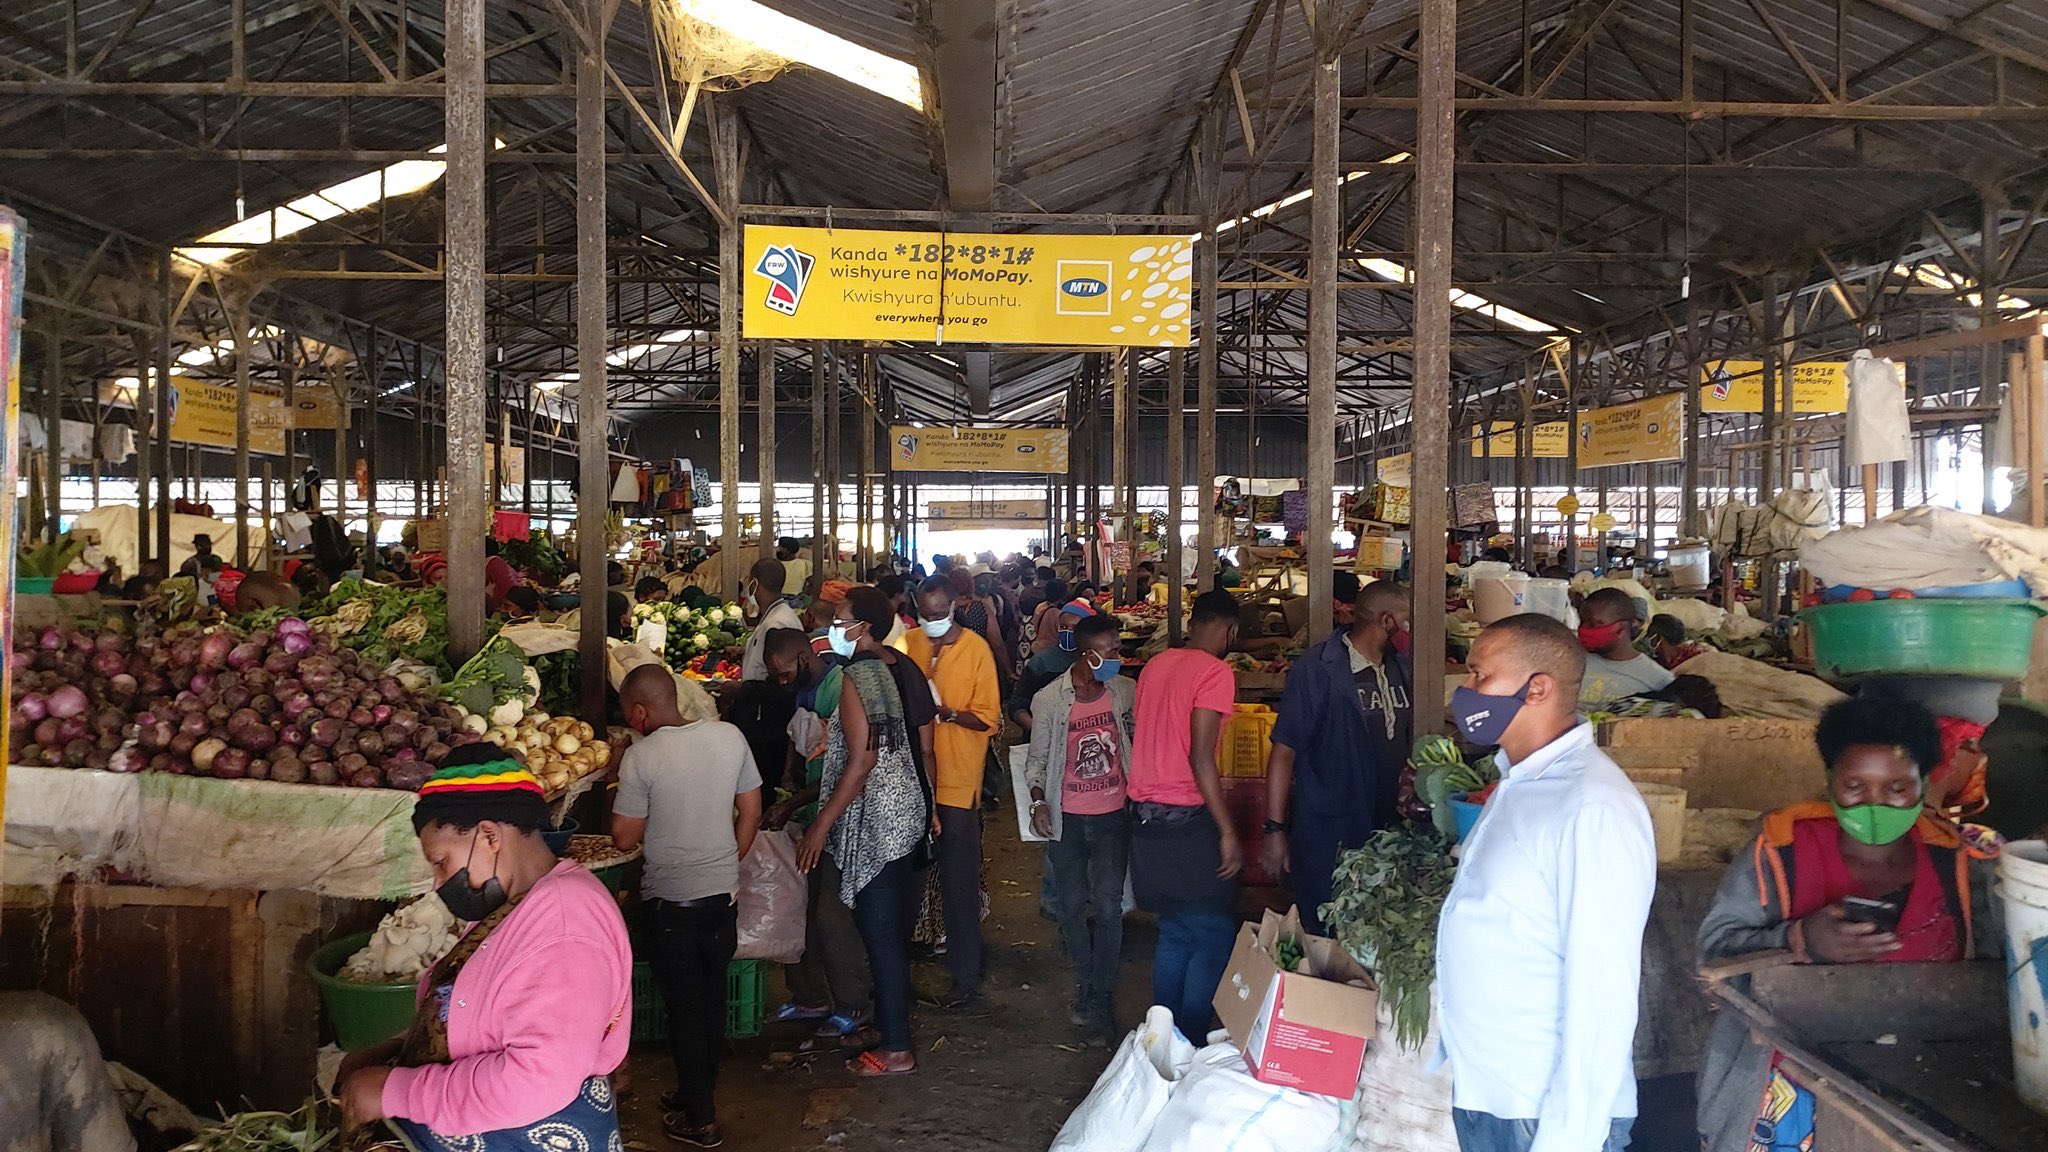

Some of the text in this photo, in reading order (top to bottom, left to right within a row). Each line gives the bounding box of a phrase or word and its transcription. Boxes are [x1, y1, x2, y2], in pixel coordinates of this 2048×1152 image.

[830, 246, 887, 262] Kanda
[829, 264, 1034, 287] wishyure na MoMoPay.
[1068, 281, 1100, 294] MTN
[843, 289, 933, 308] Kwishyura
[875, 313, 988, 327] everywher you go
[1075, 712, 1109, 730] DARTH
